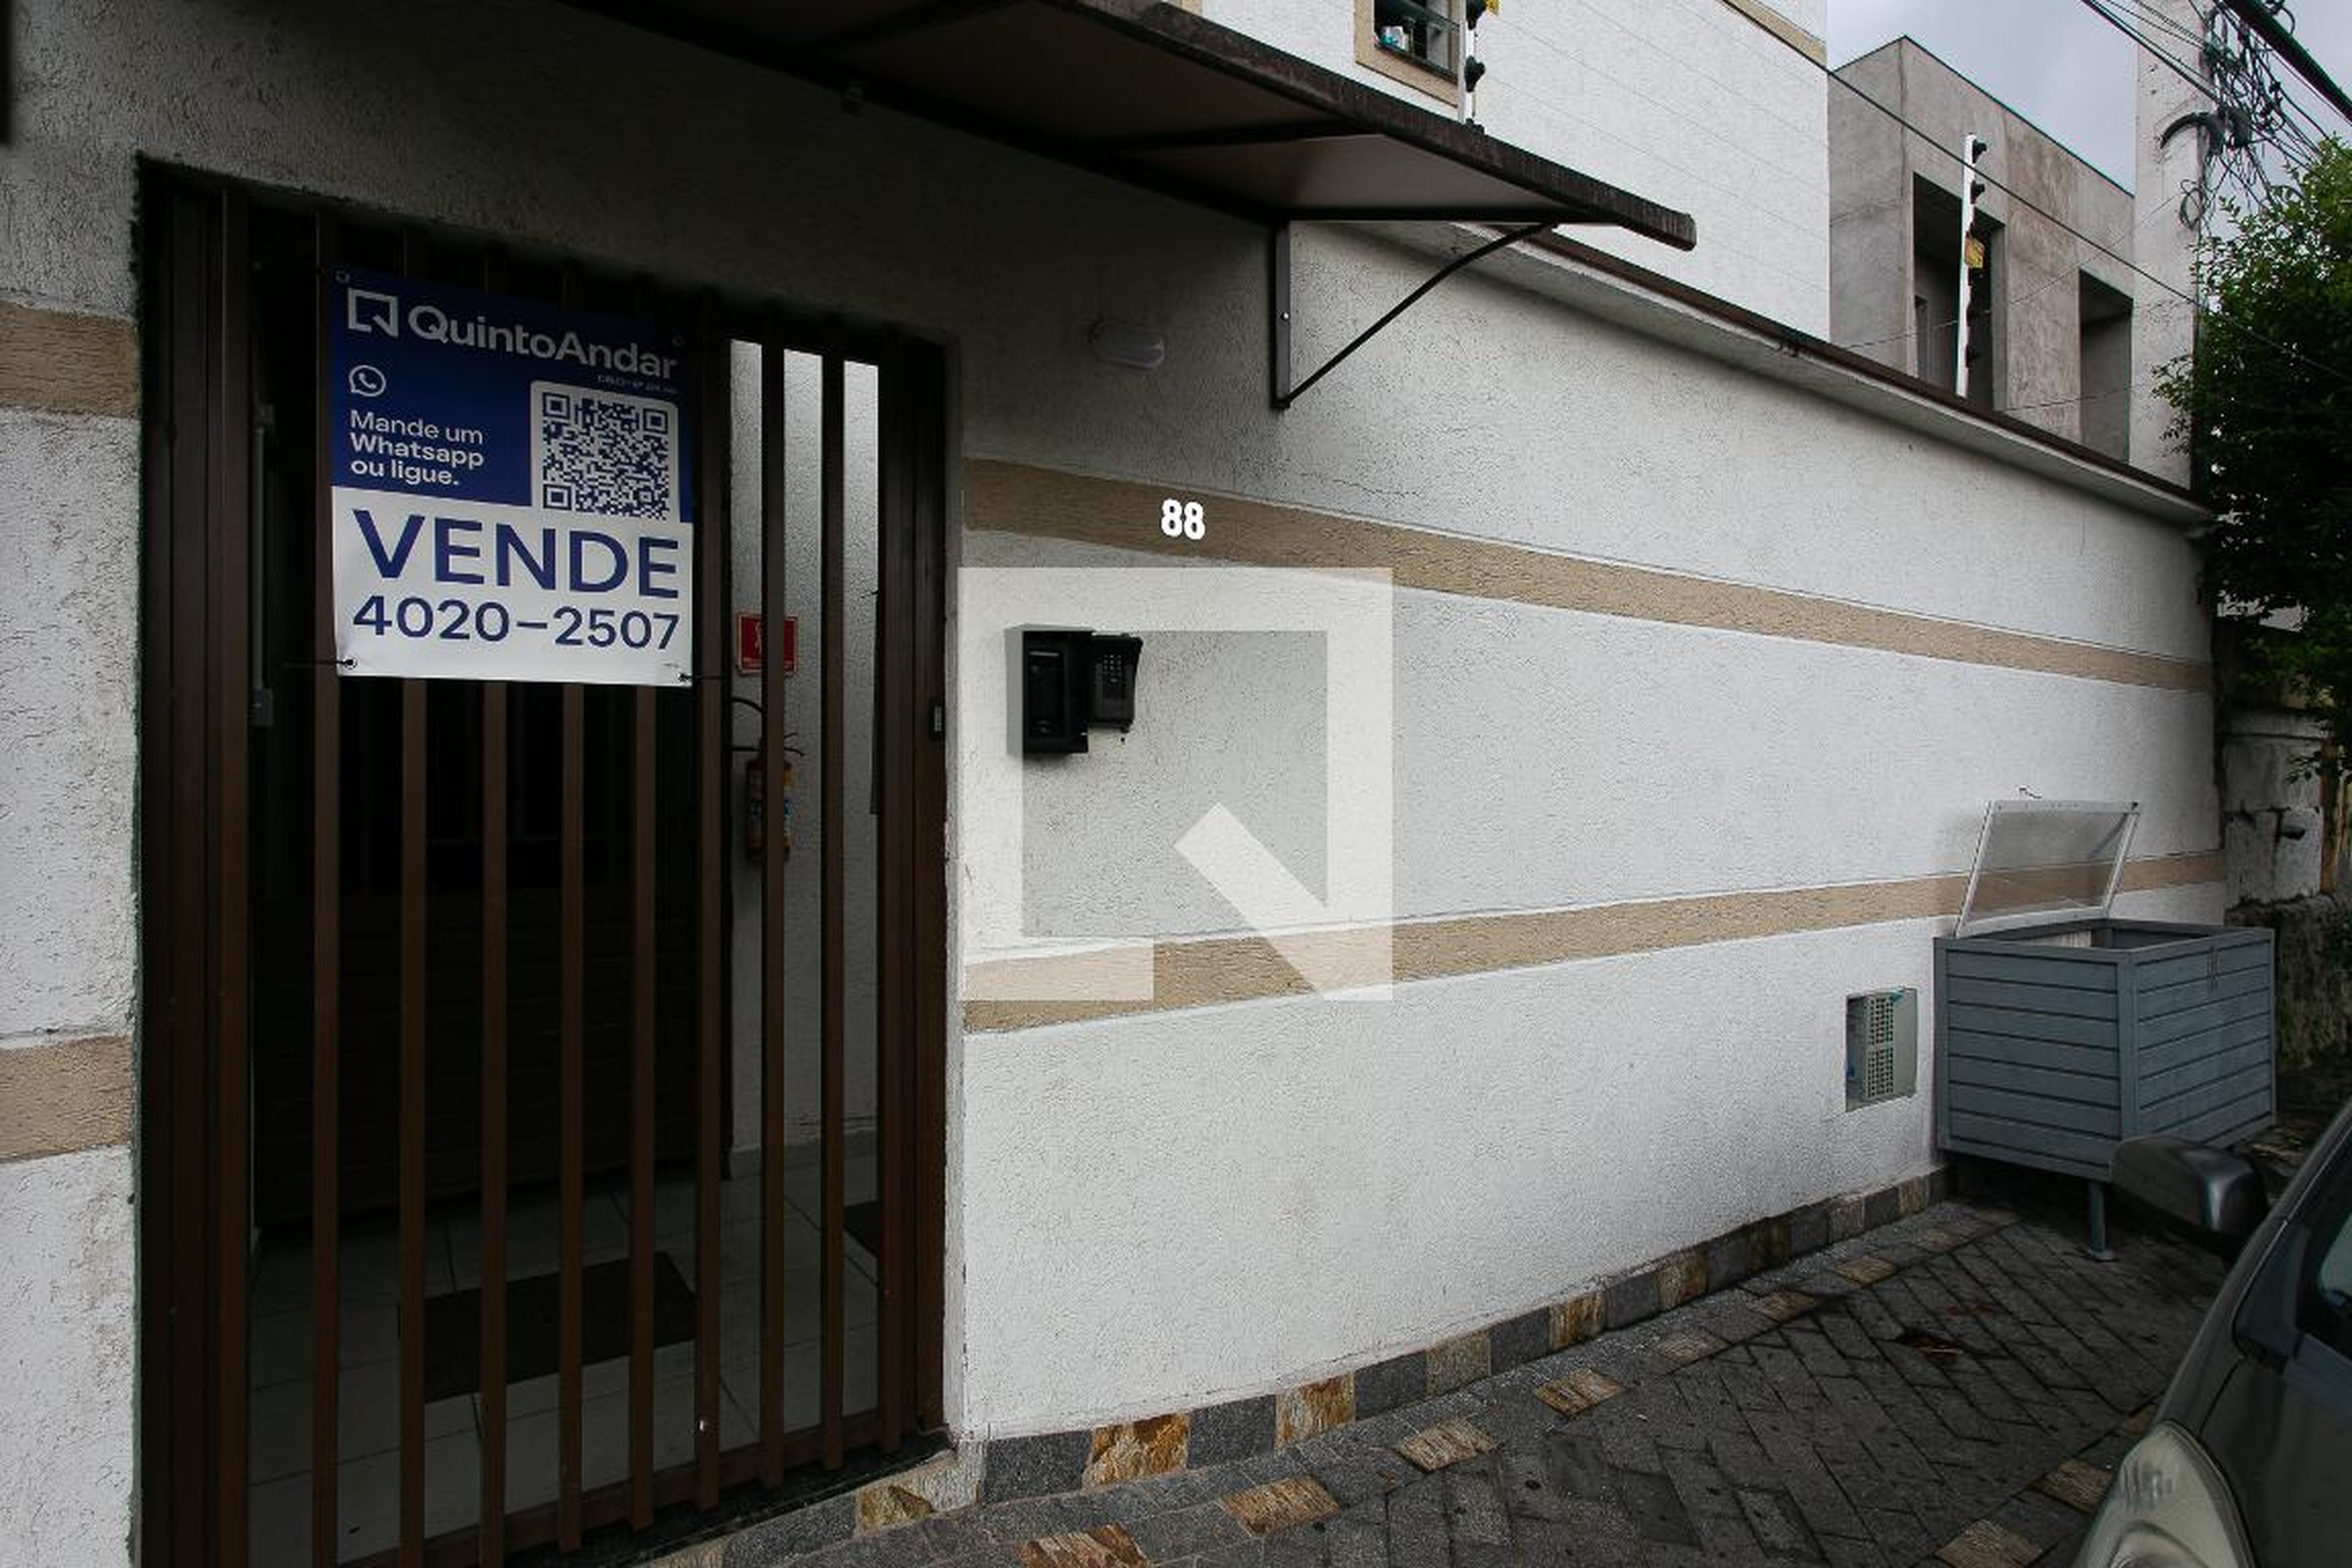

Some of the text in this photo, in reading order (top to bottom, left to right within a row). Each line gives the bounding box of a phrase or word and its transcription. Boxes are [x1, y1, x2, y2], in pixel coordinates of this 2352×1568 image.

[408, 305, 677, 378] QuintoAndar
[350, 410, 483, 444] Mande um
[350, 434, 484, 469] Whatsapp
[351, 459, 459, 485] ou ligue.
[1161, 499, 1205, 540] 88
[353, 509, 679, 599] VENDE
[353, 595, 680, 650] 4020-2507
